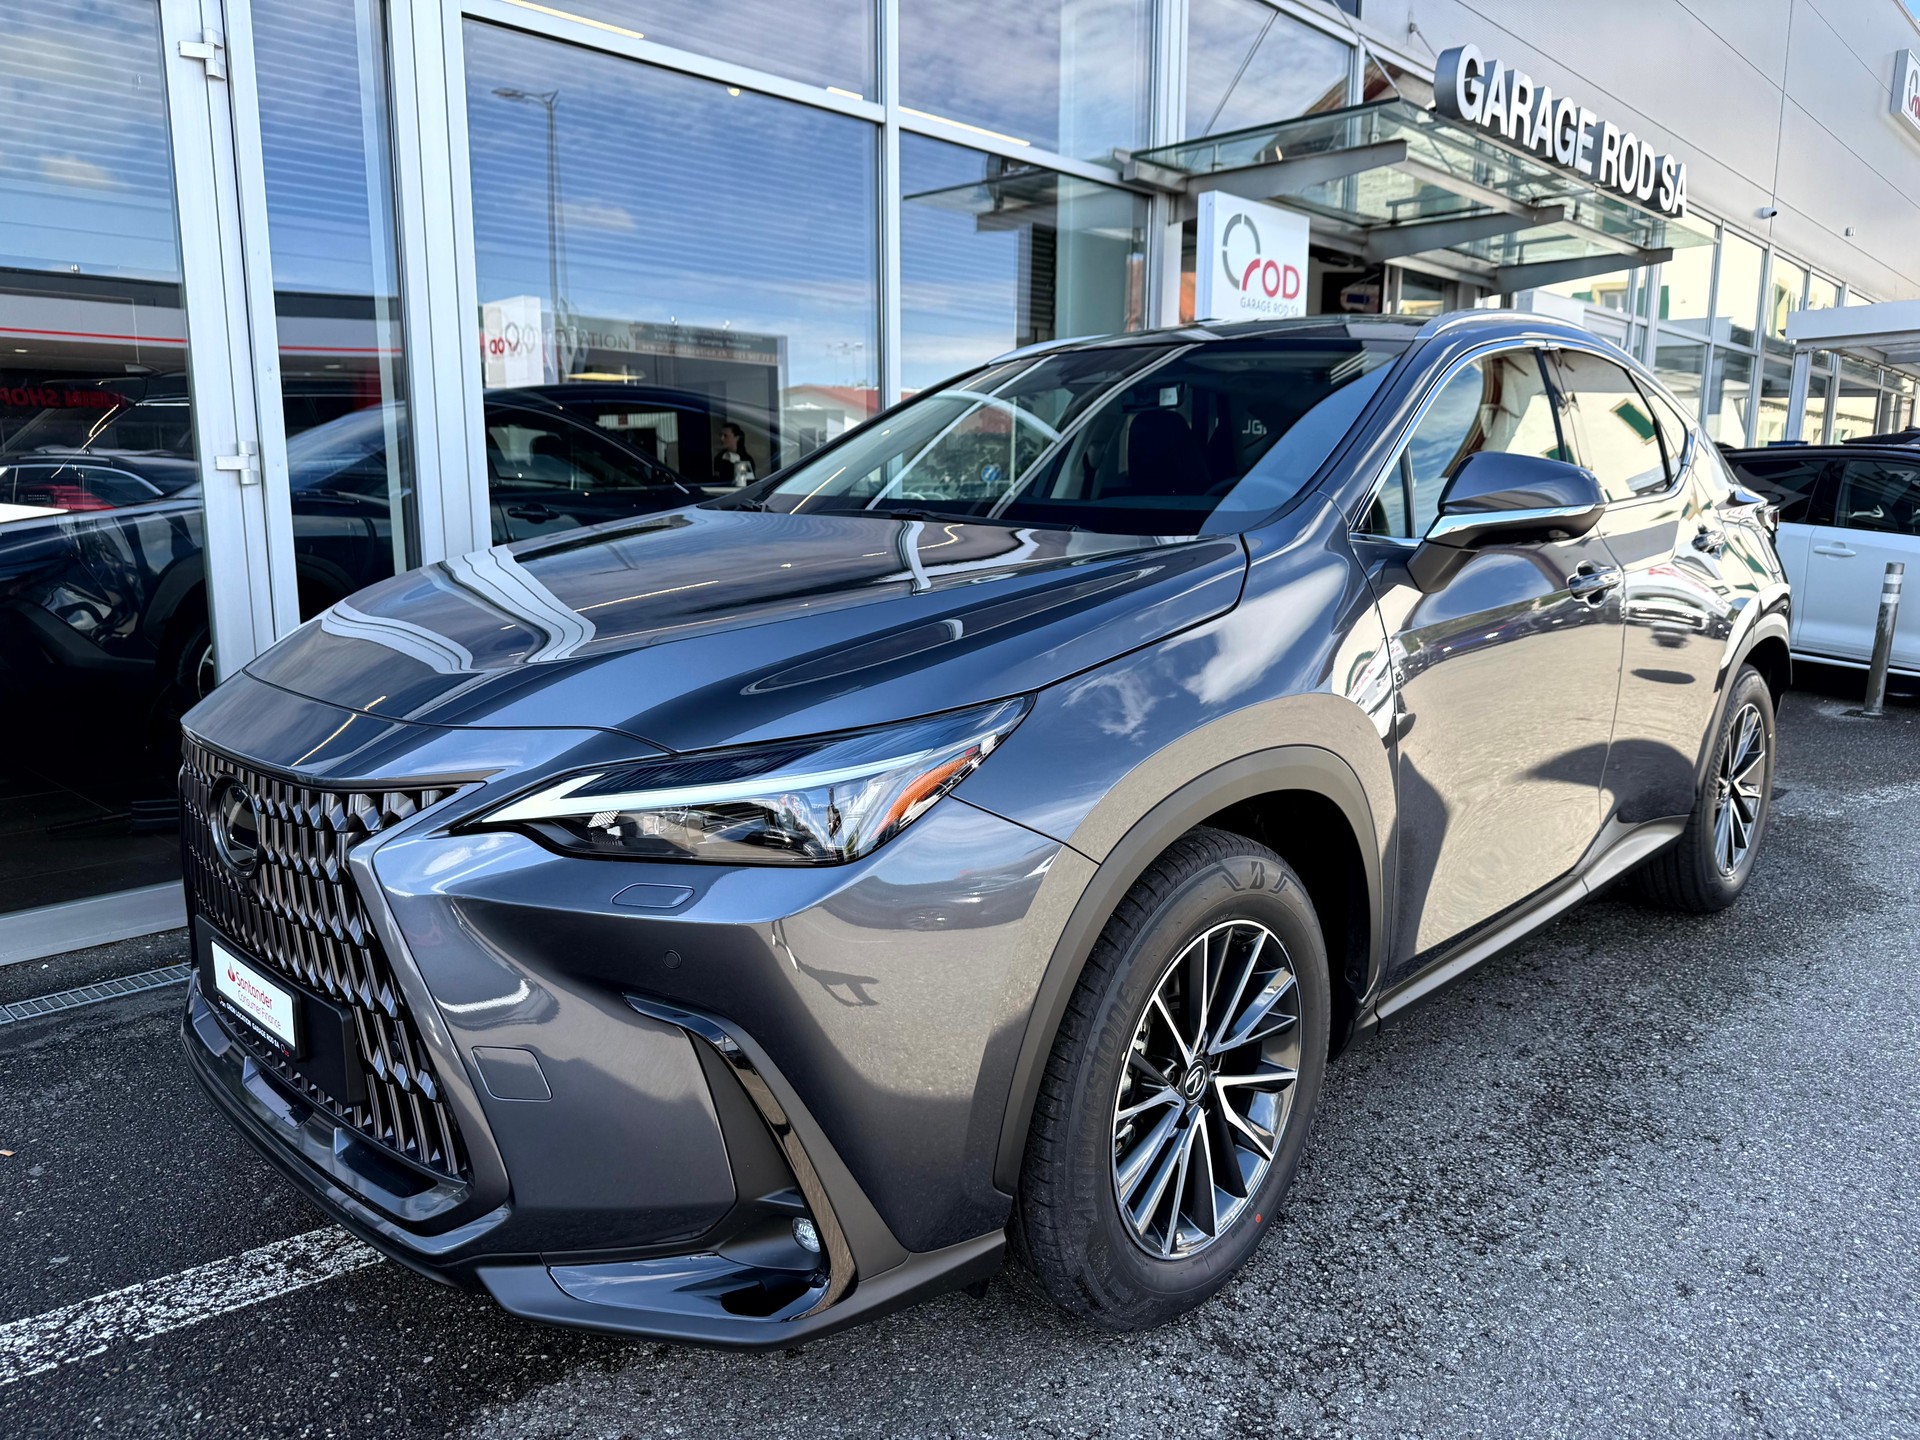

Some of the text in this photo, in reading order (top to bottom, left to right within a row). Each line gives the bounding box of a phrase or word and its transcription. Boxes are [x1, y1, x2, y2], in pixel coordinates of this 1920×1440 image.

[1456, 43, 1688, 216] GARAGE ROD SA
[1240, 297, 1272, 313] GARAGE
[235, 971, 273, 1010] Santander
